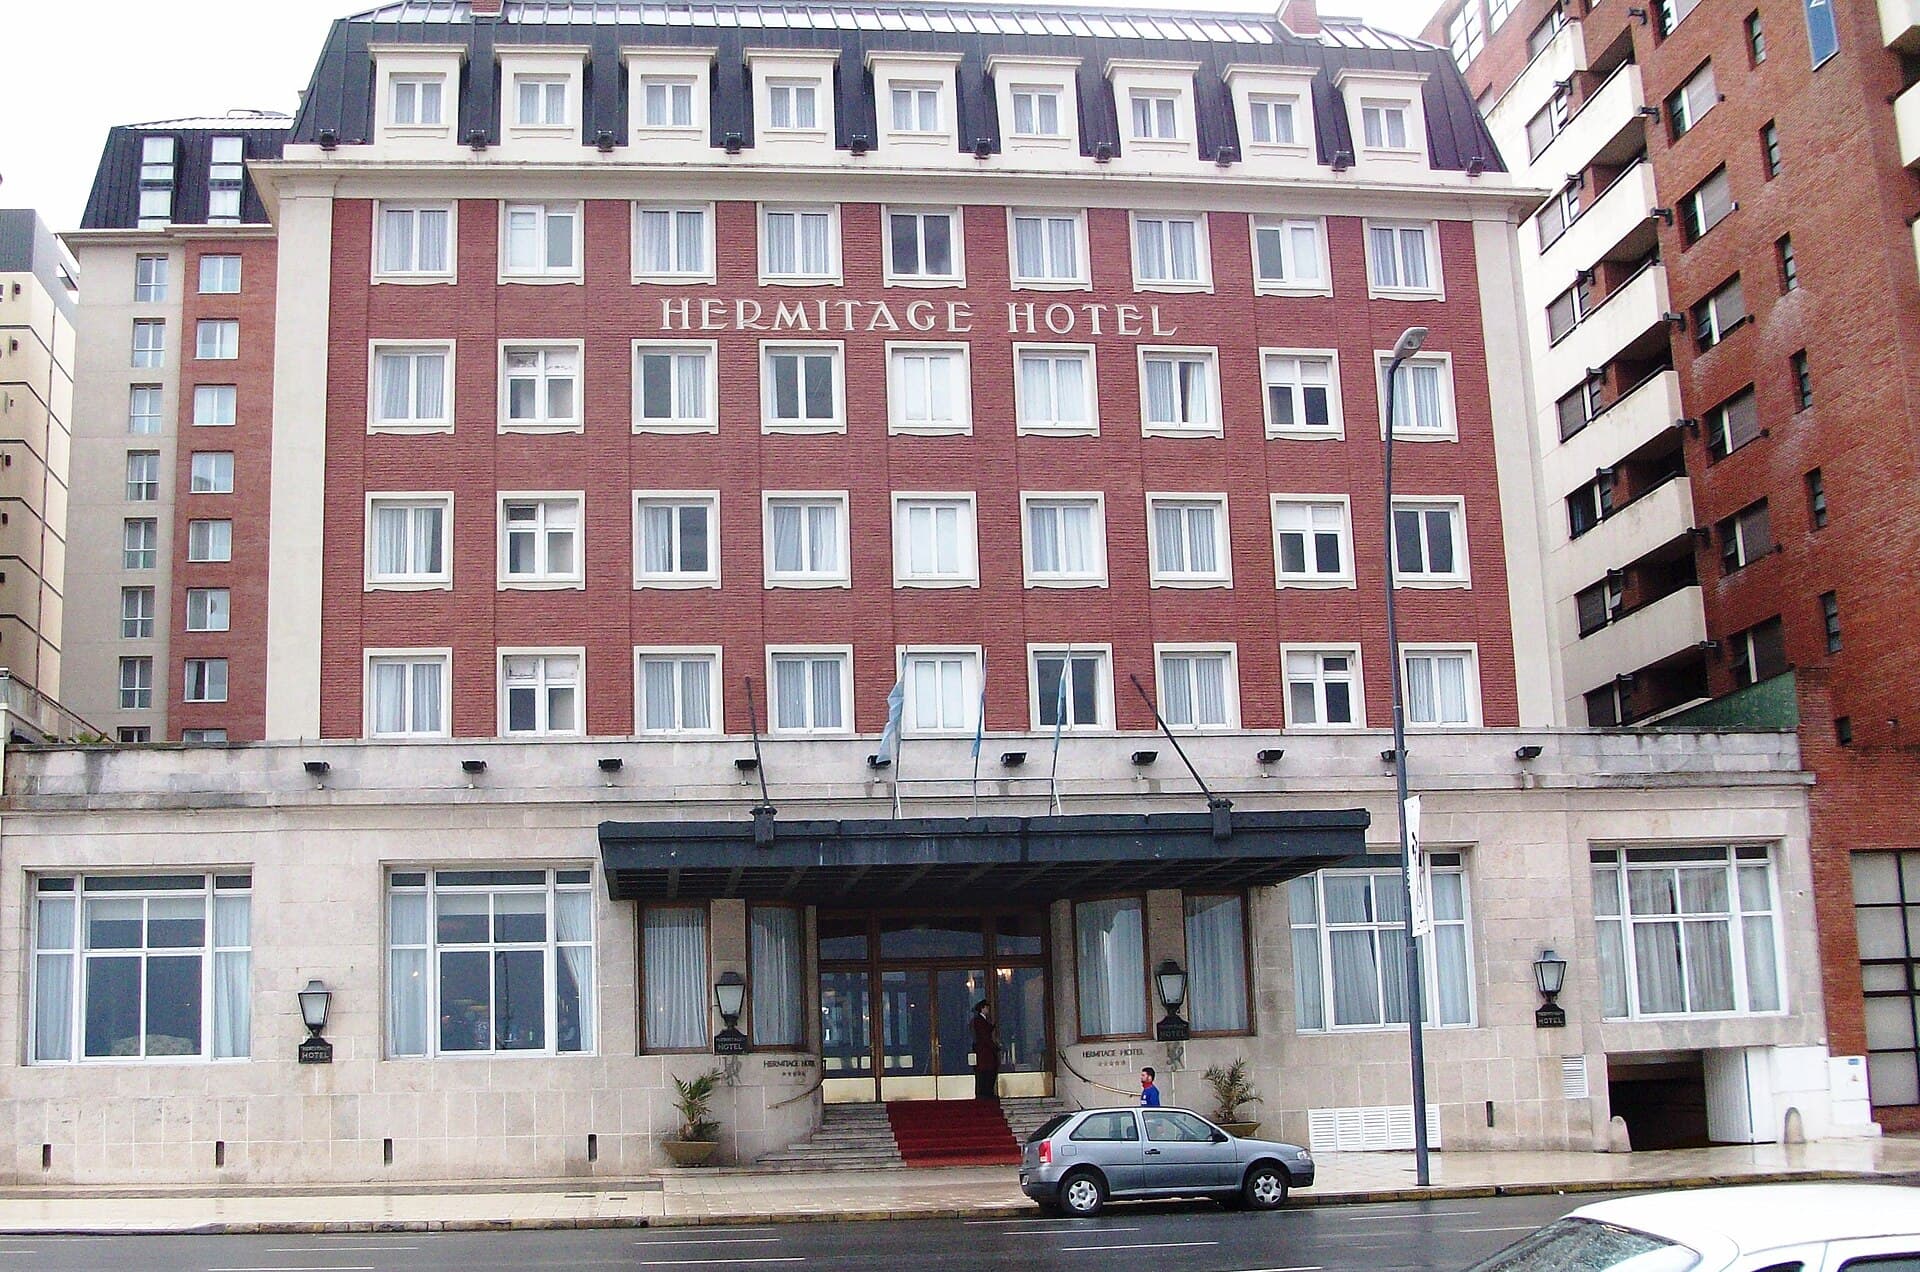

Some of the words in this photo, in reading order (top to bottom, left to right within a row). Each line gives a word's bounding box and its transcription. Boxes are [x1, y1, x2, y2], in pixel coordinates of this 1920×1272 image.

[659, 298, 974, 332] HERMITAGE
[1006, 302, 1178, 336] HOTEL
[302, 1051, 330, 1059] HOTEL
[1082, 1049, 1116, 1058] HERMITAGE
[1120, 1048, 1144, 1056] HOTEL
